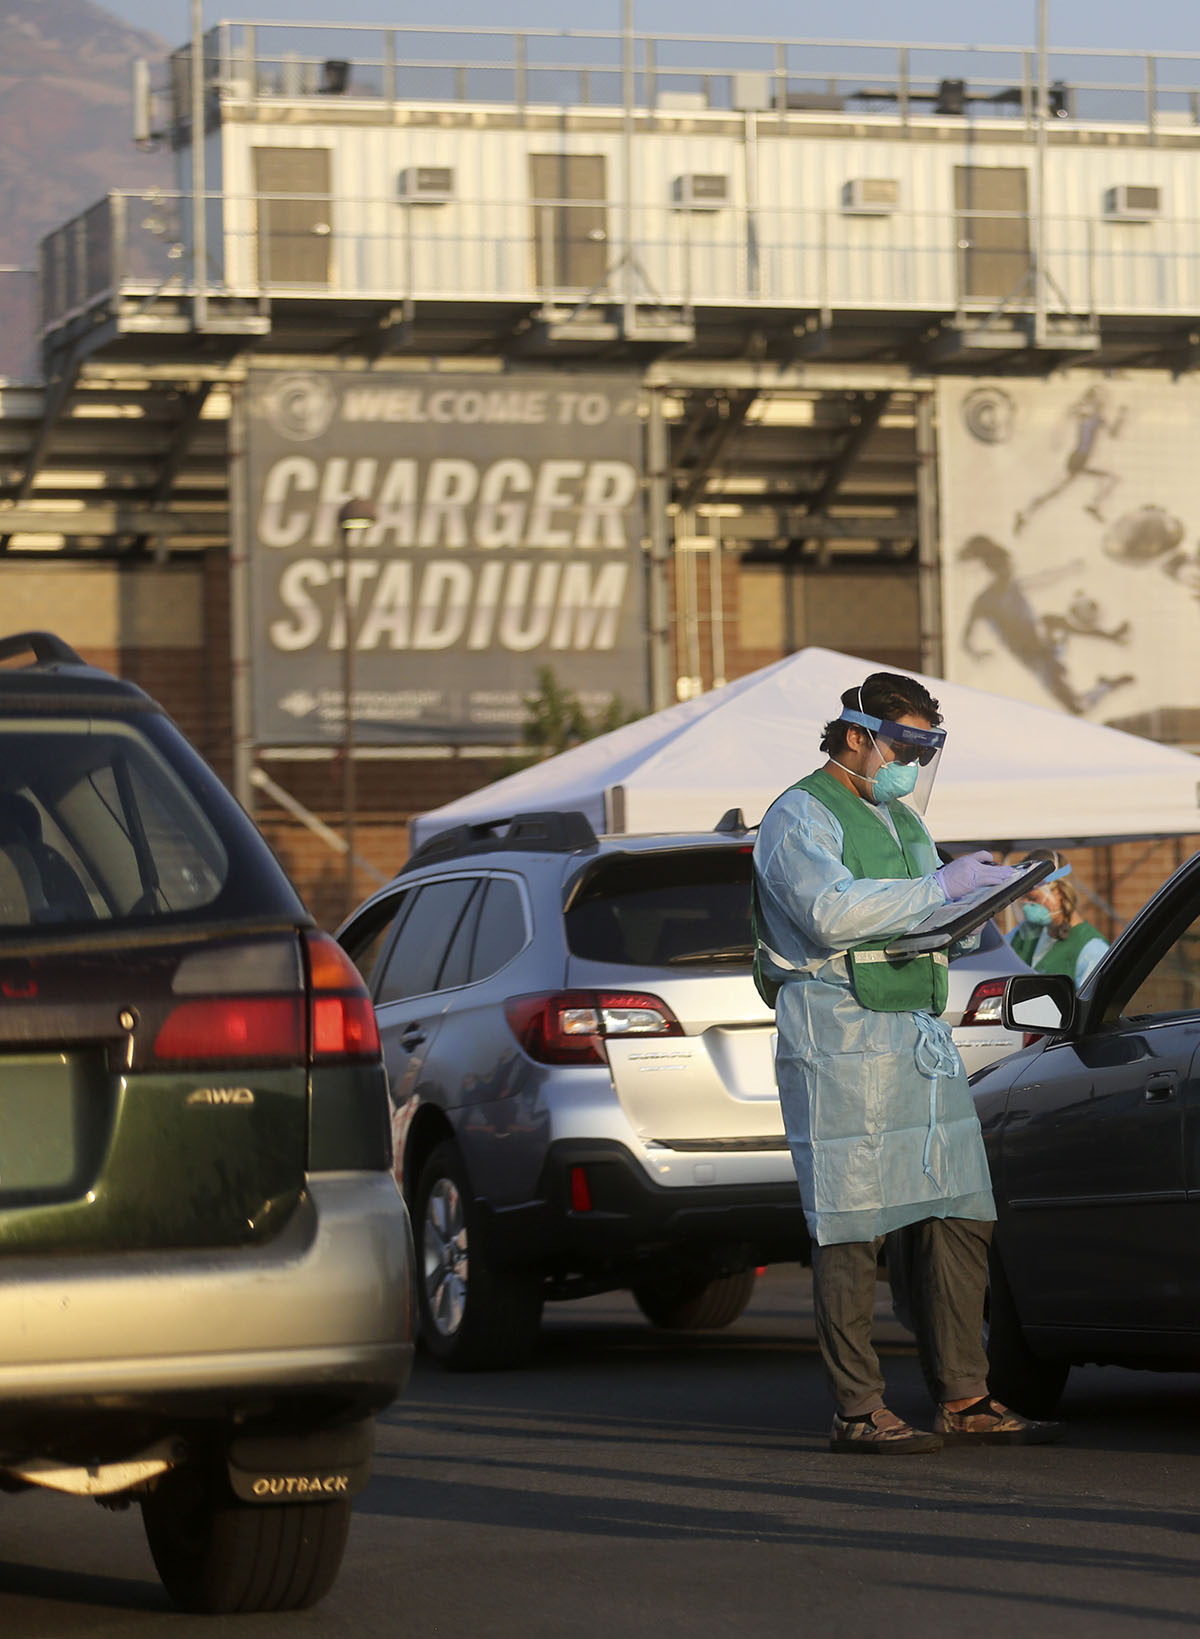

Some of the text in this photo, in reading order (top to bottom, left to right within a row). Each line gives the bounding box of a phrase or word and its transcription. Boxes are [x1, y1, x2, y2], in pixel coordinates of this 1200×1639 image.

[343, 388, 611, 426] WELCOME TO
[257, 456, 638, 550] CHARGER
[270, 559, 630, 652] STADIUM
[186, 1087, 255, 1104] AWD
[252, 1476, 349, 1496] OUTBACK
